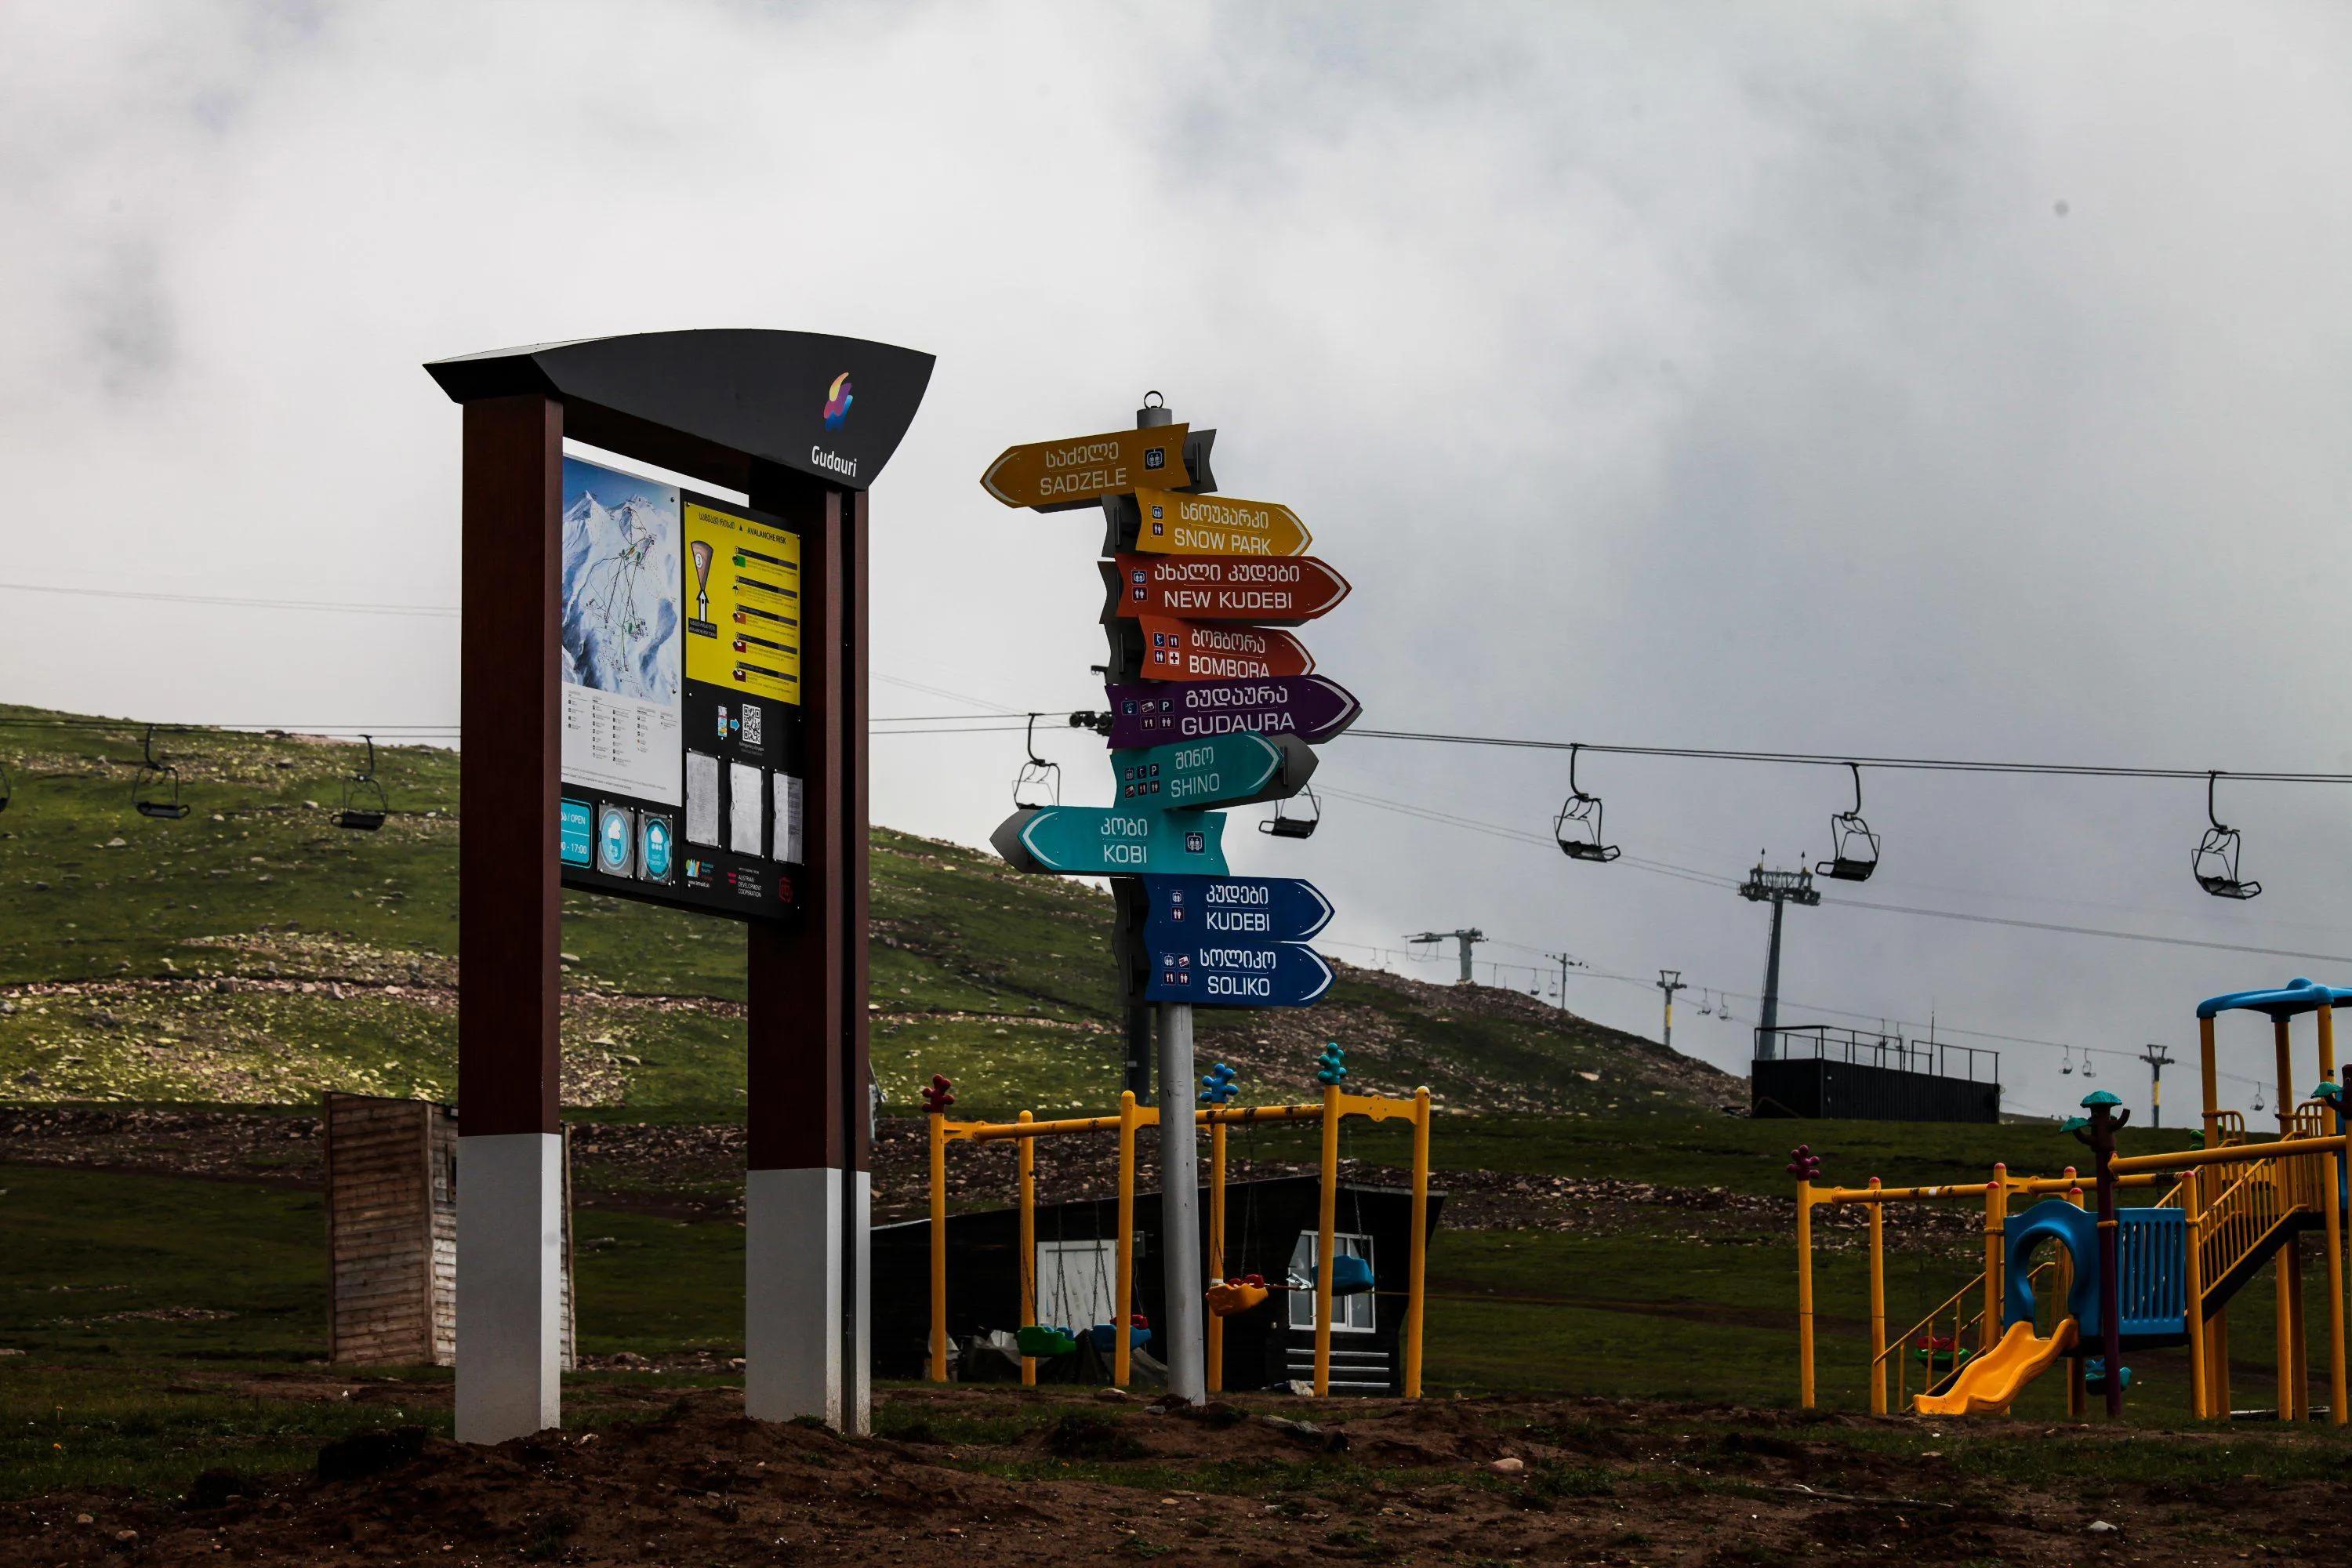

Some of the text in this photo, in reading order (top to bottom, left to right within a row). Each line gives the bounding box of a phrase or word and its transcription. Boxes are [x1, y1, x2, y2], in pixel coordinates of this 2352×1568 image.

[811, 445, 858, 477] Gudauri
[1046, 441, 1119, 468] საძელე
[1040, 468, 1127, 495] SADZELE
[1180, 502, 1269, 528] სნოუპარკი
[747, 527, 786, 545] AVALANCHE RISK
[1174, 528, 1272, 556] SNOW PARK
[1154, 564, 1300, 583] ახალი კუდები
[1164, 591, 1292, 609] NEW KUDEBI
[1191, 629, 1265, 654] ბომბორა
[1189, 655, 1270, 678] BOMBORA
[1162, 701, 1170, 711] P
[1185, 685, 1288, 708] გუდაურა
[1181, 712, 1295, 735] GUDAURA
[1175, 746, 1214, 770] შინო
[1171, 772, 1220, 798] SHINO
[571, 814, 586, 826] OPEN
[1101, 817, 1148, 837] კობი
[572, 843, 587, 855] 17:00
[1103, 844, 1147, 863] KOBI
[1206, 884, 1269, 905] კუდები
[1206, 912, 1270, 931] KUDEBI
[1200, 948, 1276, 969] სოლიკო
[1207, 975, 1270, 996] SOLIKO
